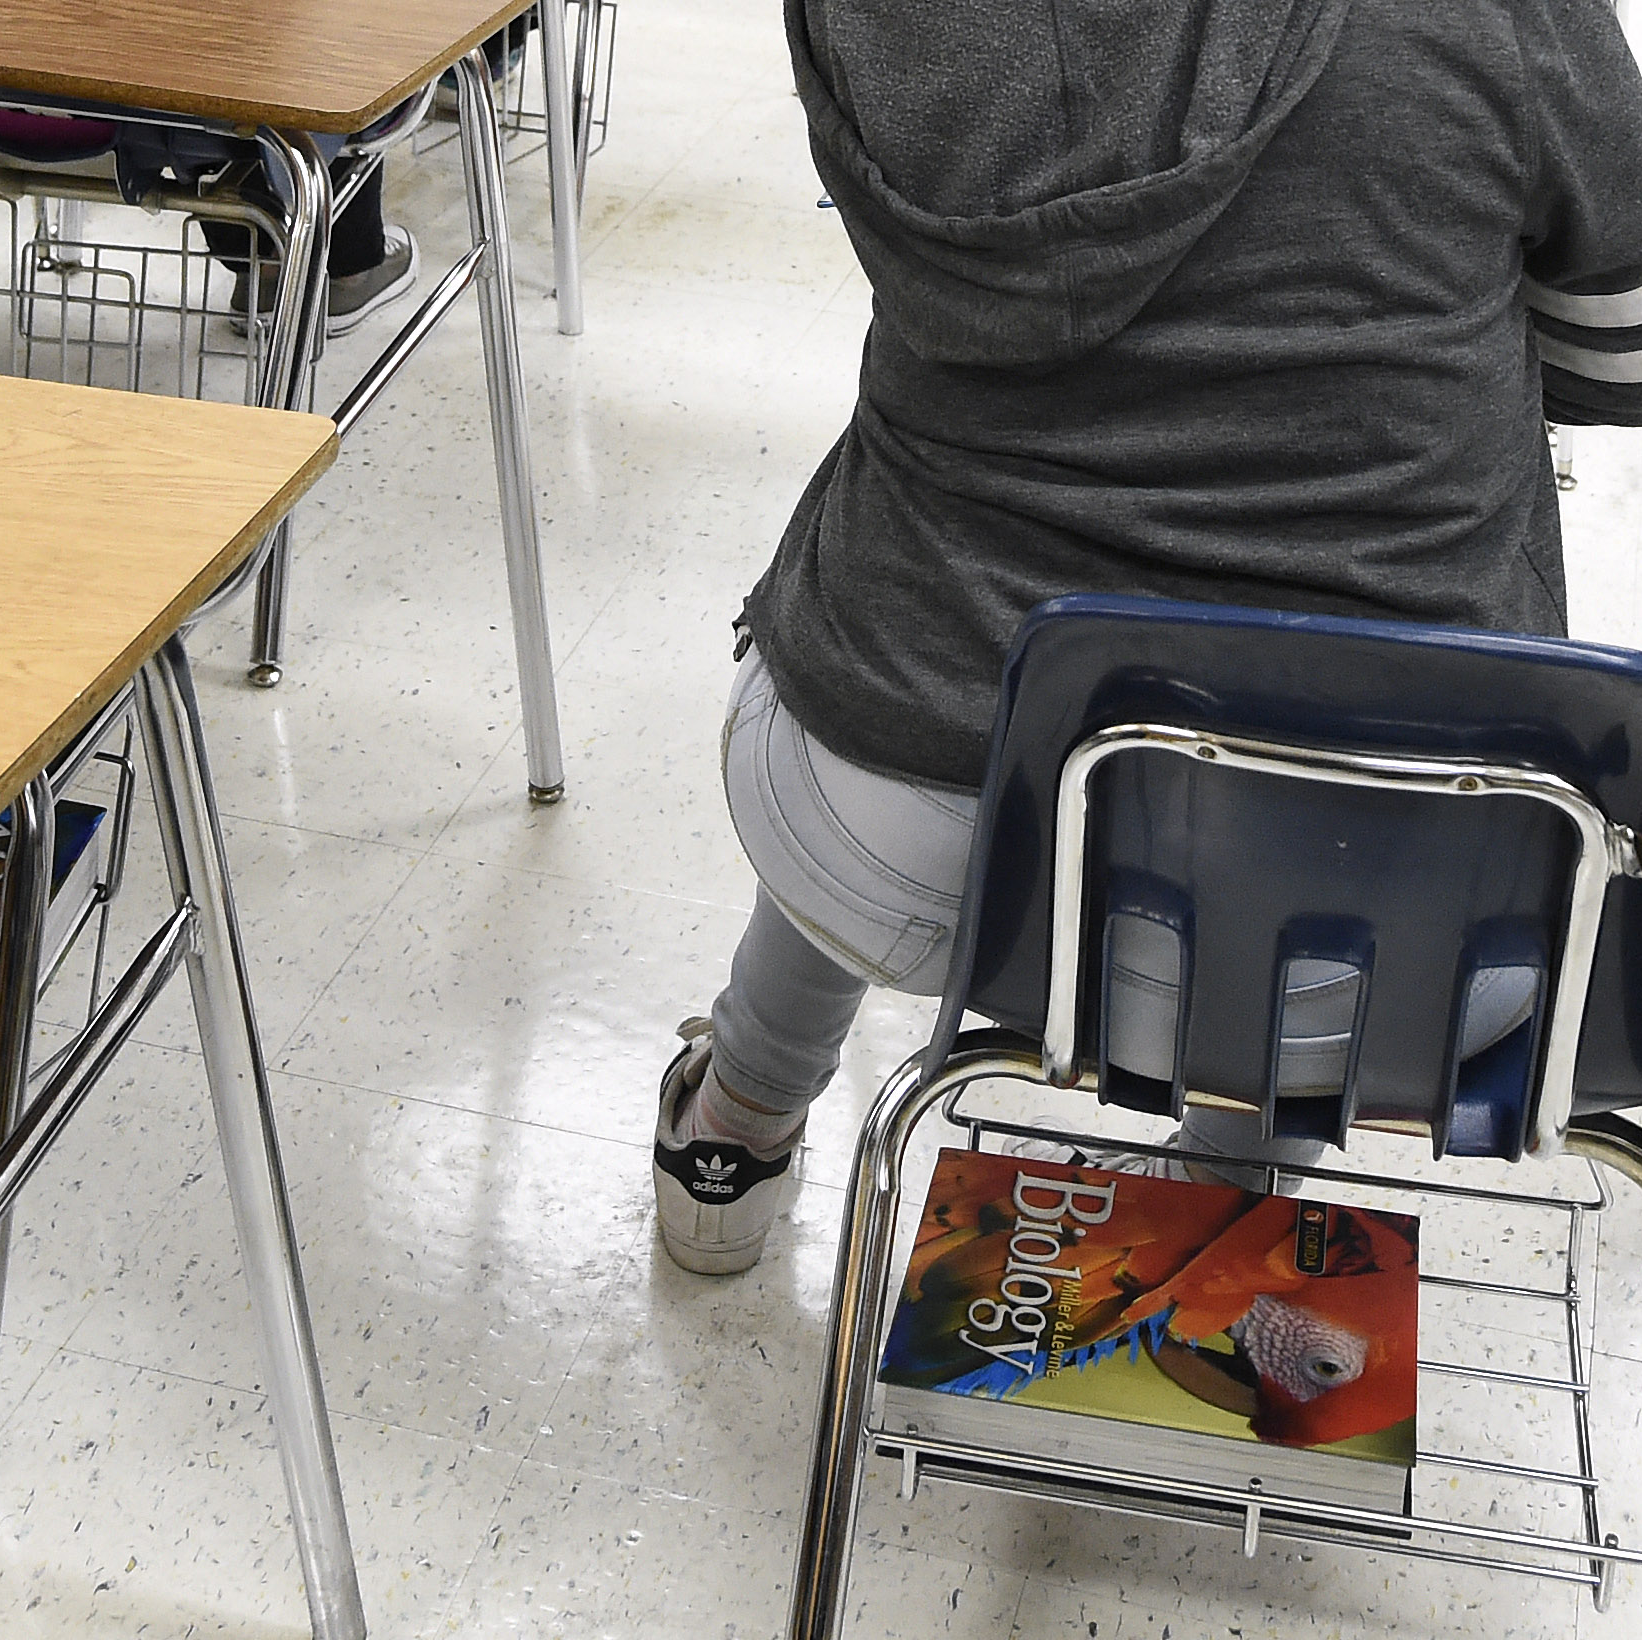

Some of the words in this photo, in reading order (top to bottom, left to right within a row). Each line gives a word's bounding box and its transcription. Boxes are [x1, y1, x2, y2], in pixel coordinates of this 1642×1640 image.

[692, 1180, 734, 1195] adidas
[1304, 1225, 1322, 1268] FLORIDA
[959, 1169, 1118, 1378] Biology
[1059, 1278, 1083, 1320] Miller
[1054, 1321, 1075, 1333] &
[1046, 1334, 1074, 1380] Levine
